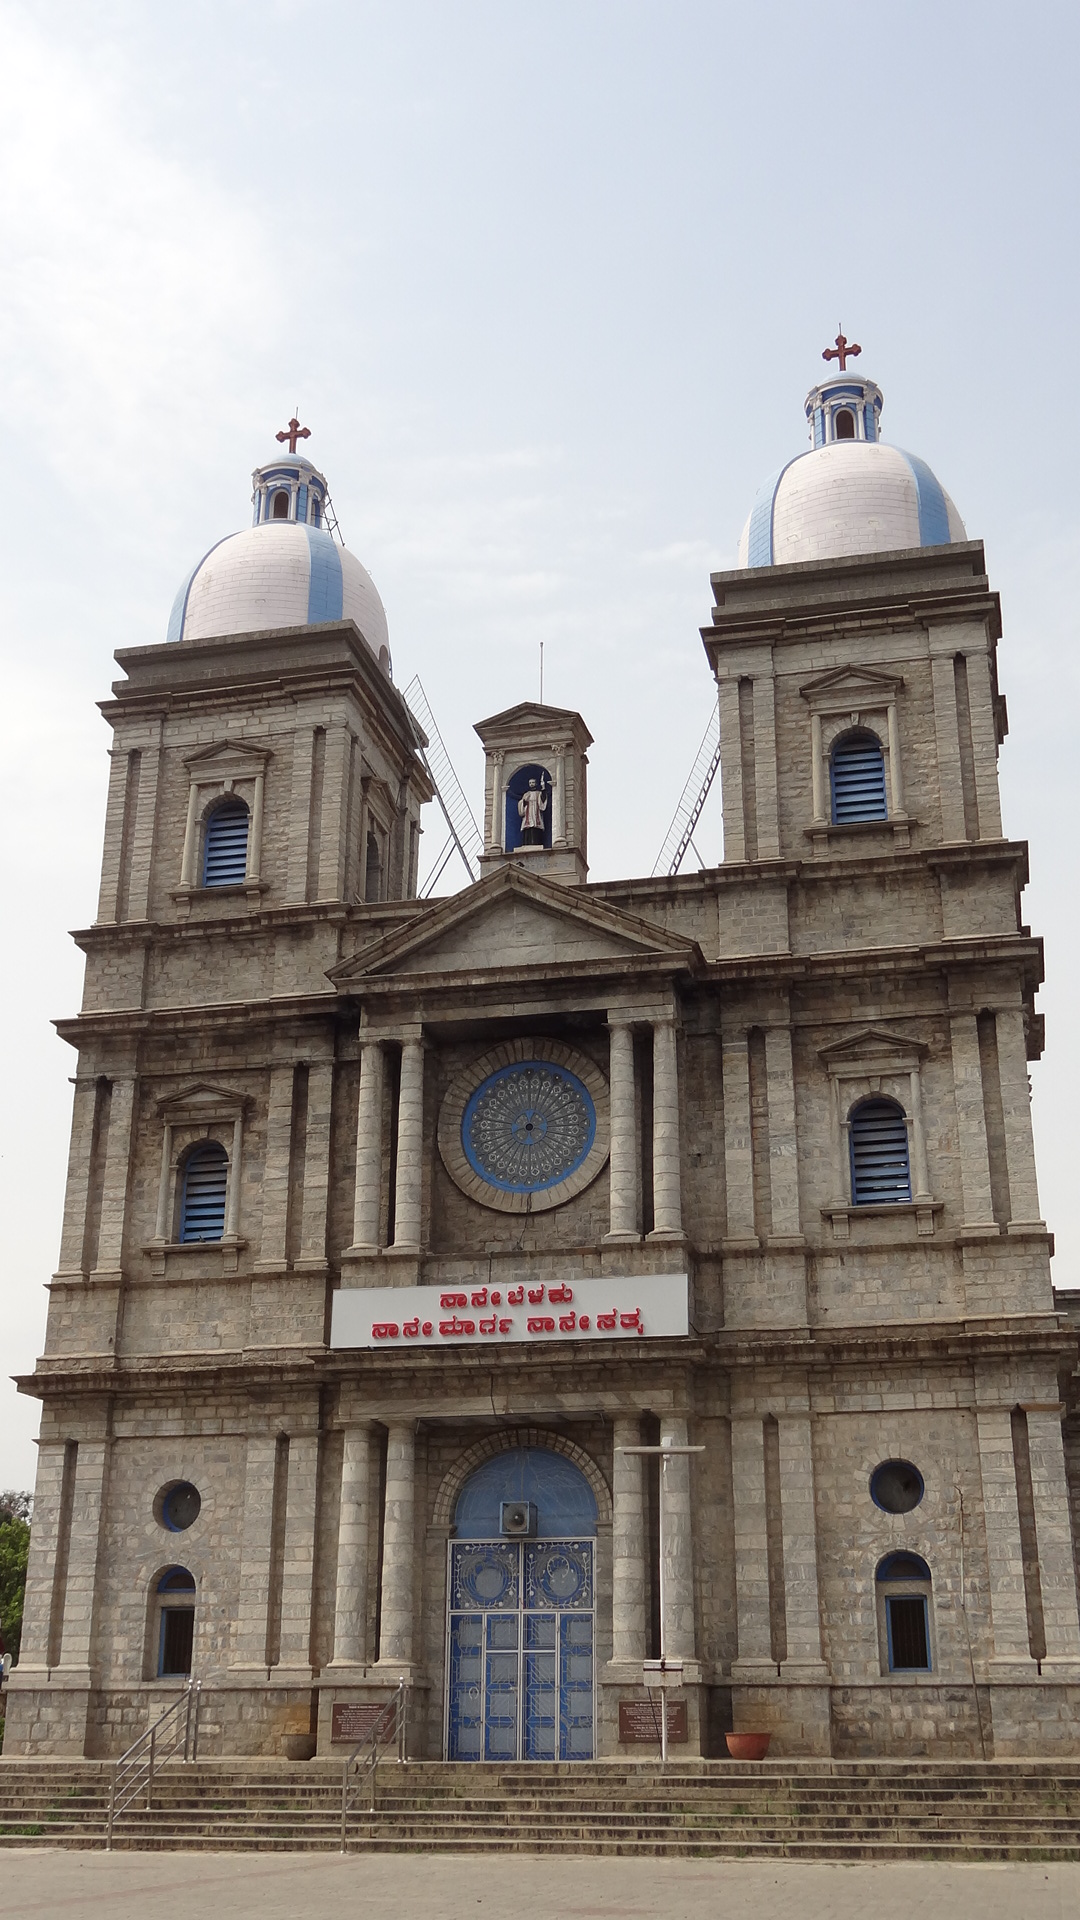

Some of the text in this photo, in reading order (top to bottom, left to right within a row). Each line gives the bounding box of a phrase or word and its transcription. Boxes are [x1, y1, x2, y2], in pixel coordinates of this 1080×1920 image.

[440, 1283, 574, 1309] ನಾನೇ ಬೆಳಕು
[371, 1307, 644, 1339] ನಾನೇ ಮಾರ್ಗ ನಾನೇ ಸತ್ಯ
